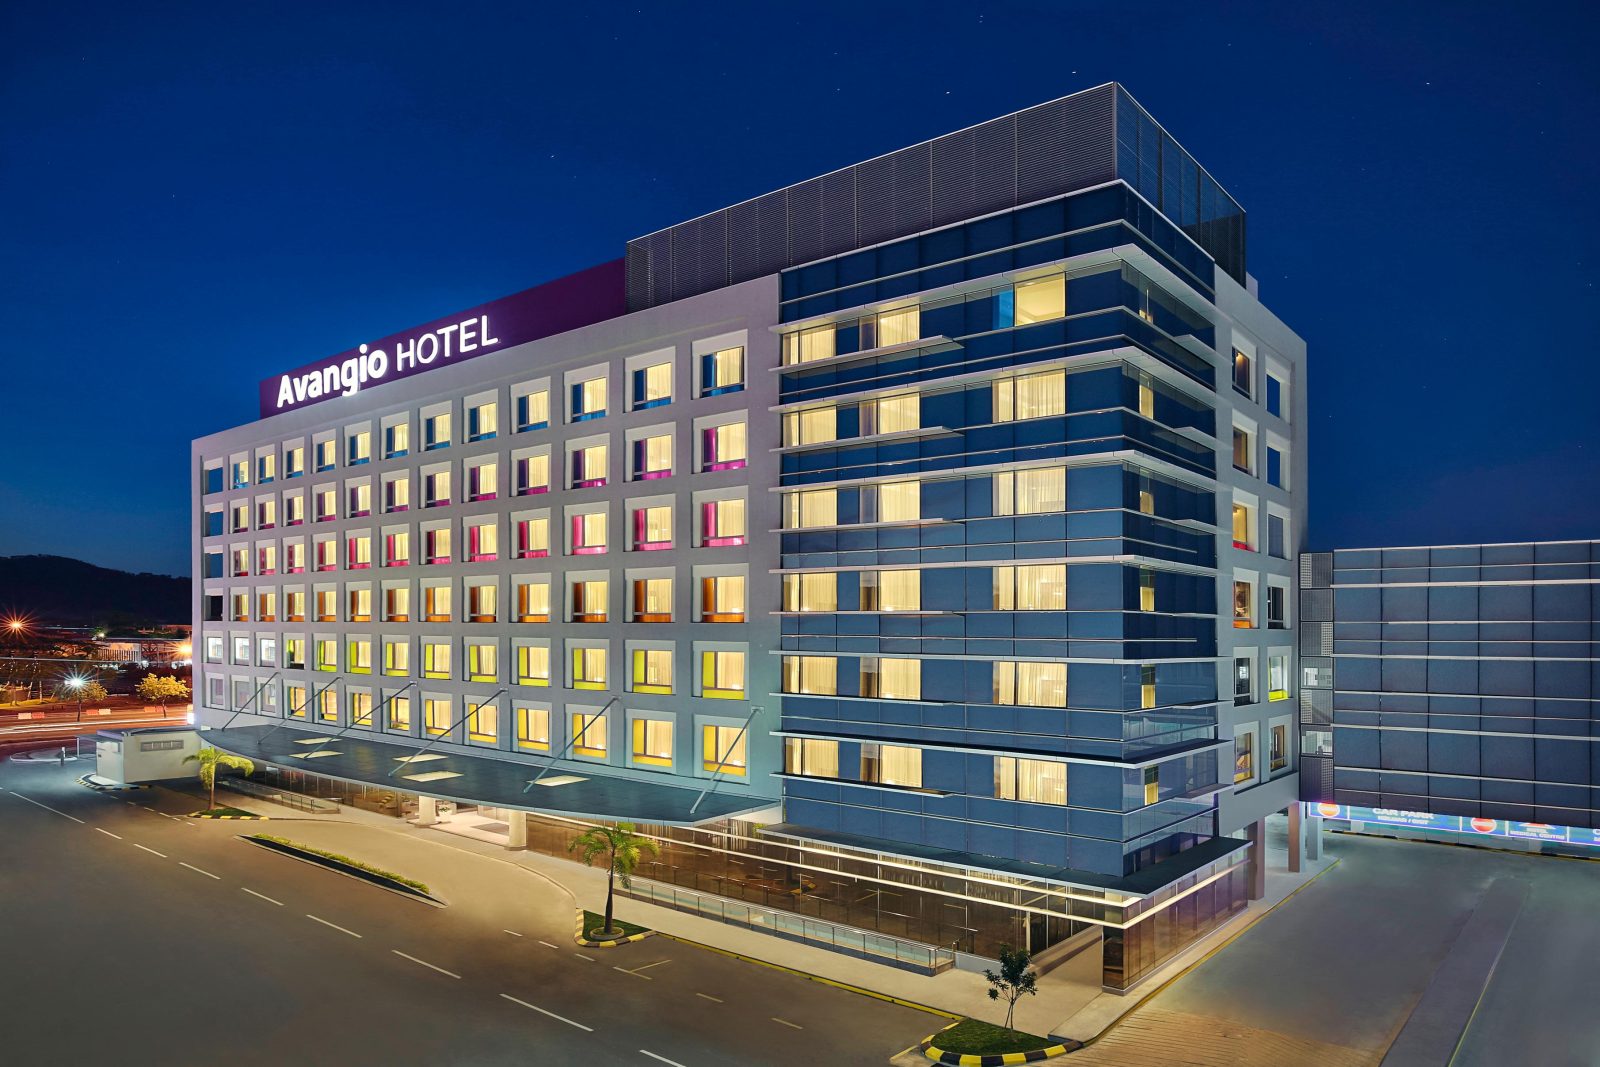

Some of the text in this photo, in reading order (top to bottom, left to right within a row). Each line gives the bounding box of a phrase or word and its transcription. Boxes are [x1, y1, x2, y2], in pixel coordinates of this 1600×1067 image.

[276, 315, 499, 408] Avangio HOTEL
[1372, 808, 1399, 817] CAR
[1400, 810, 1435, 820] PARK
